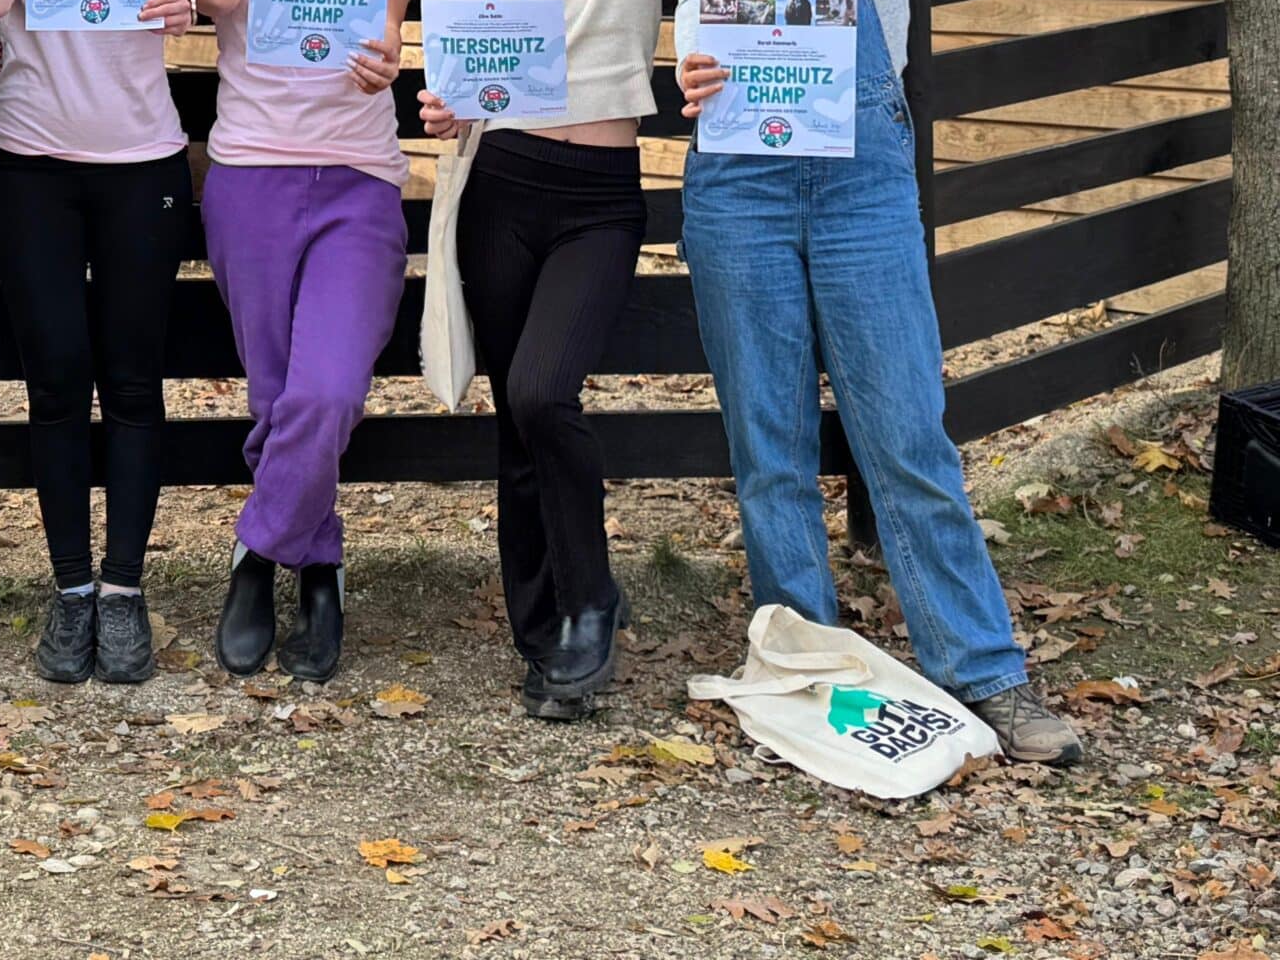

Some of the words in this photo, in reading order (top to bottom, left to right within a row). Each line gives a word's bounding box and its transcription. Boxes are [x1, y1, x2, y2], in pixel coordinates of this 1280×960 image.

[291, 5, 344, 24] CHAMP
[440, 37, 545, 55] TIERSCHUTZ
[465, 56, 520, 74] CHAMP
[747, 86, 806, 105] CHAMP
